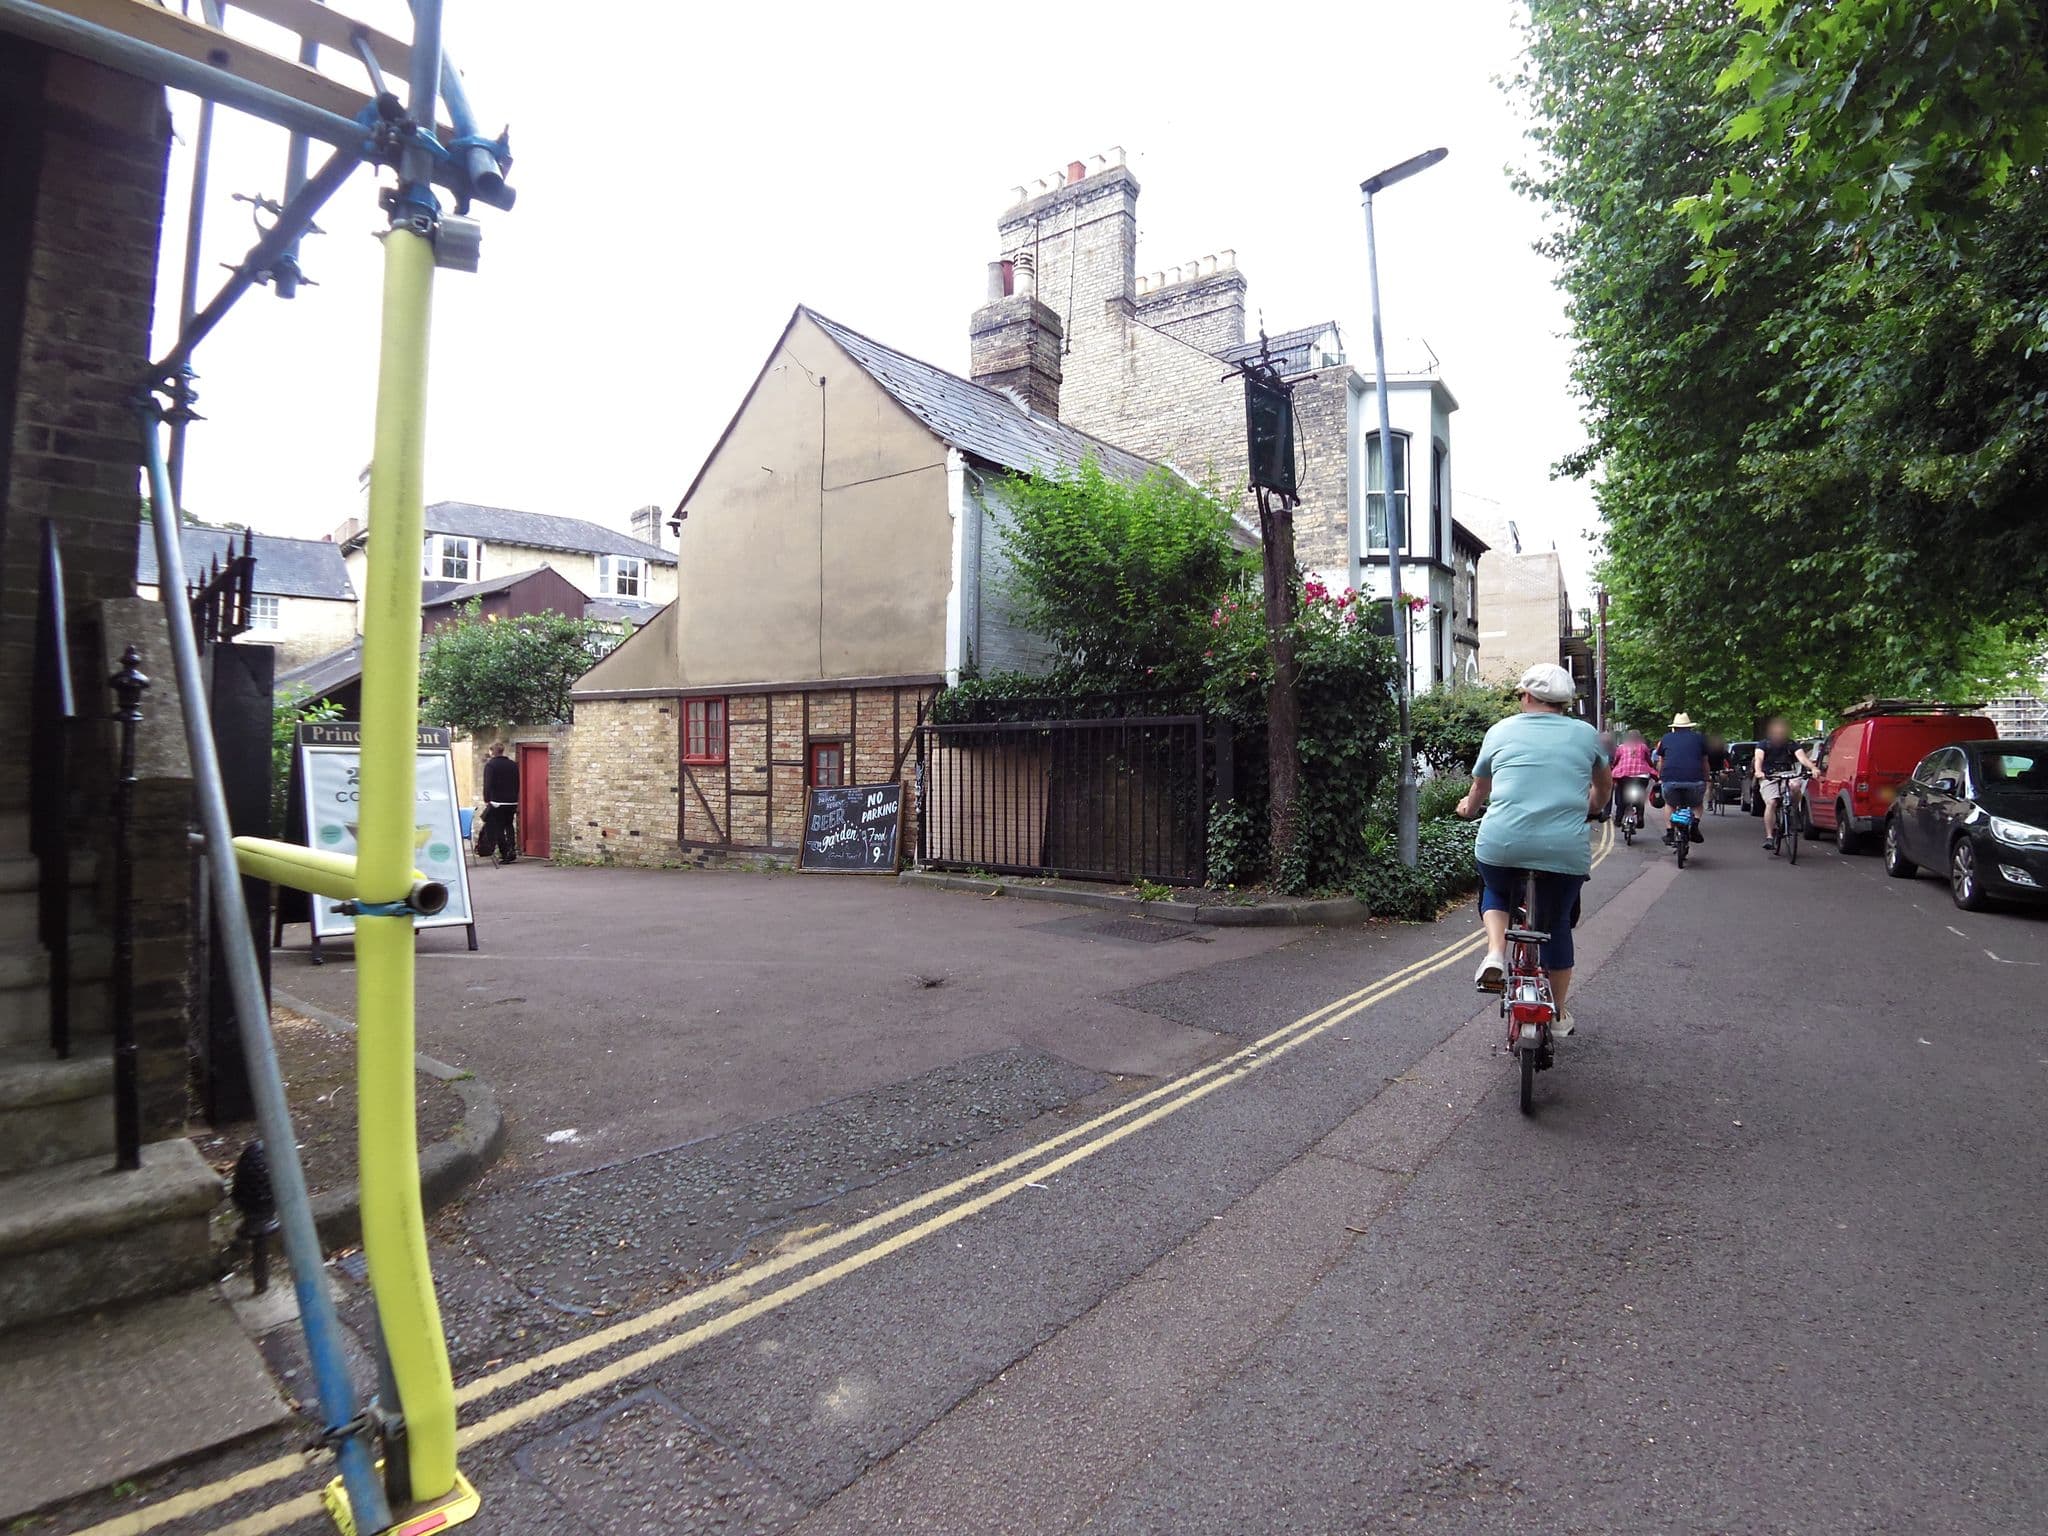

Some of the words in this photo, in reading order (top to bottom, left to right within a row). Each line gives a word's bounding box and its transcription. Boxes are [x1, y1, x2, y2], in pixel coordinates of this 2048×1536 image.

[312, 726, 361, 741] Princ
[867, 791, 883, 807] NO
[811, 808, 846, 831] BEER
[861, 801, 898, 823] PARKING
[819, 823, 857, 853] garden
[867, 826, 887, 842] Food
